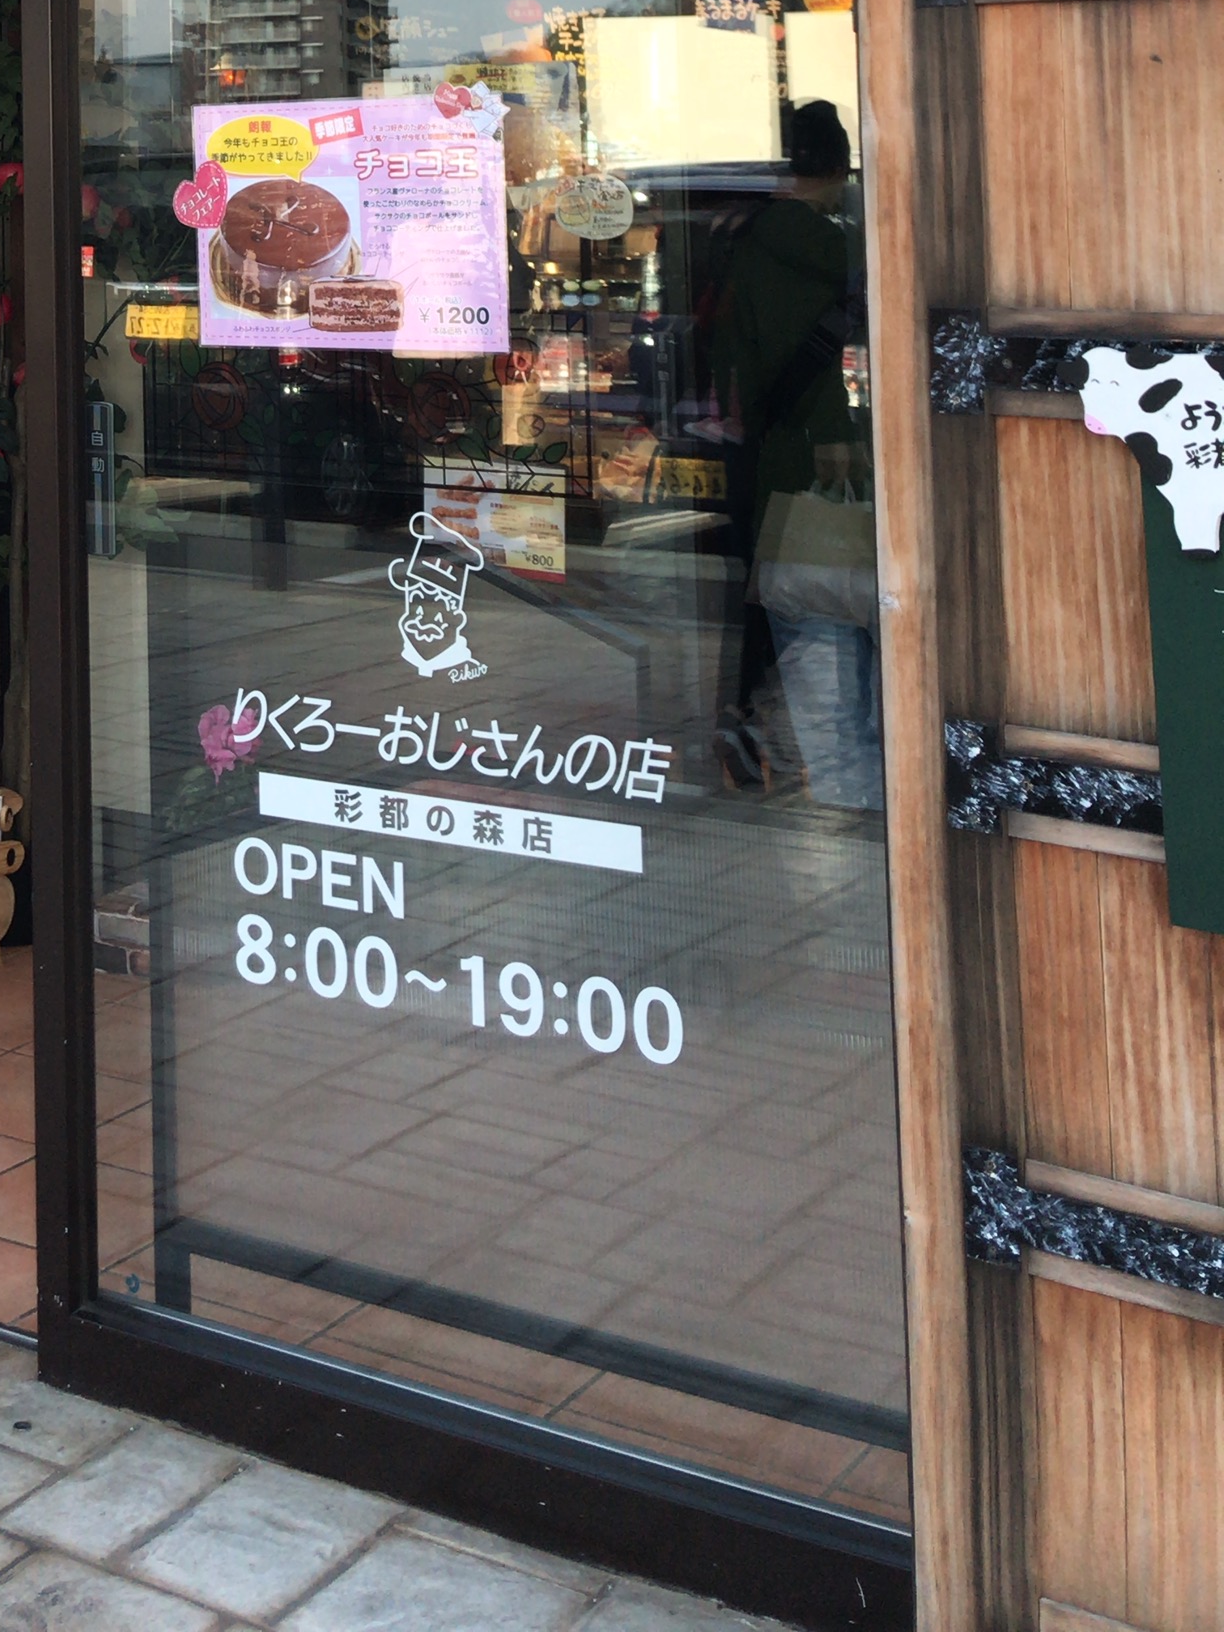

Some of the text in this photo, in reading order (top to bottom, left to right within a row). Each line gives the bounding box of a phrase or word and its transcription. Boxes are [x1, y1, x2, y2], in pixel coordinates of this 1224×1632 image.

[223, 136, 299, 148] 今年もチョコ王の
[247, 120, 273, 134] 朗報
[313, 114, 357, 140] 季節限定
[353, 145, 479, 182] チョコ王
[179, 175, 222, 217] チョコレート
[191, 194, 222, 222] フェアー
[418, 306, 491, 326] ¥1200
[1180, 399, 1224, 432] よう
[90, 430, 106, 474] 自動
[231, 687, 673, 805] りくろーおじさんの店
[333, 787, 555, 854] 彩都の森店
[233, 836, 406, 920] OPEN
